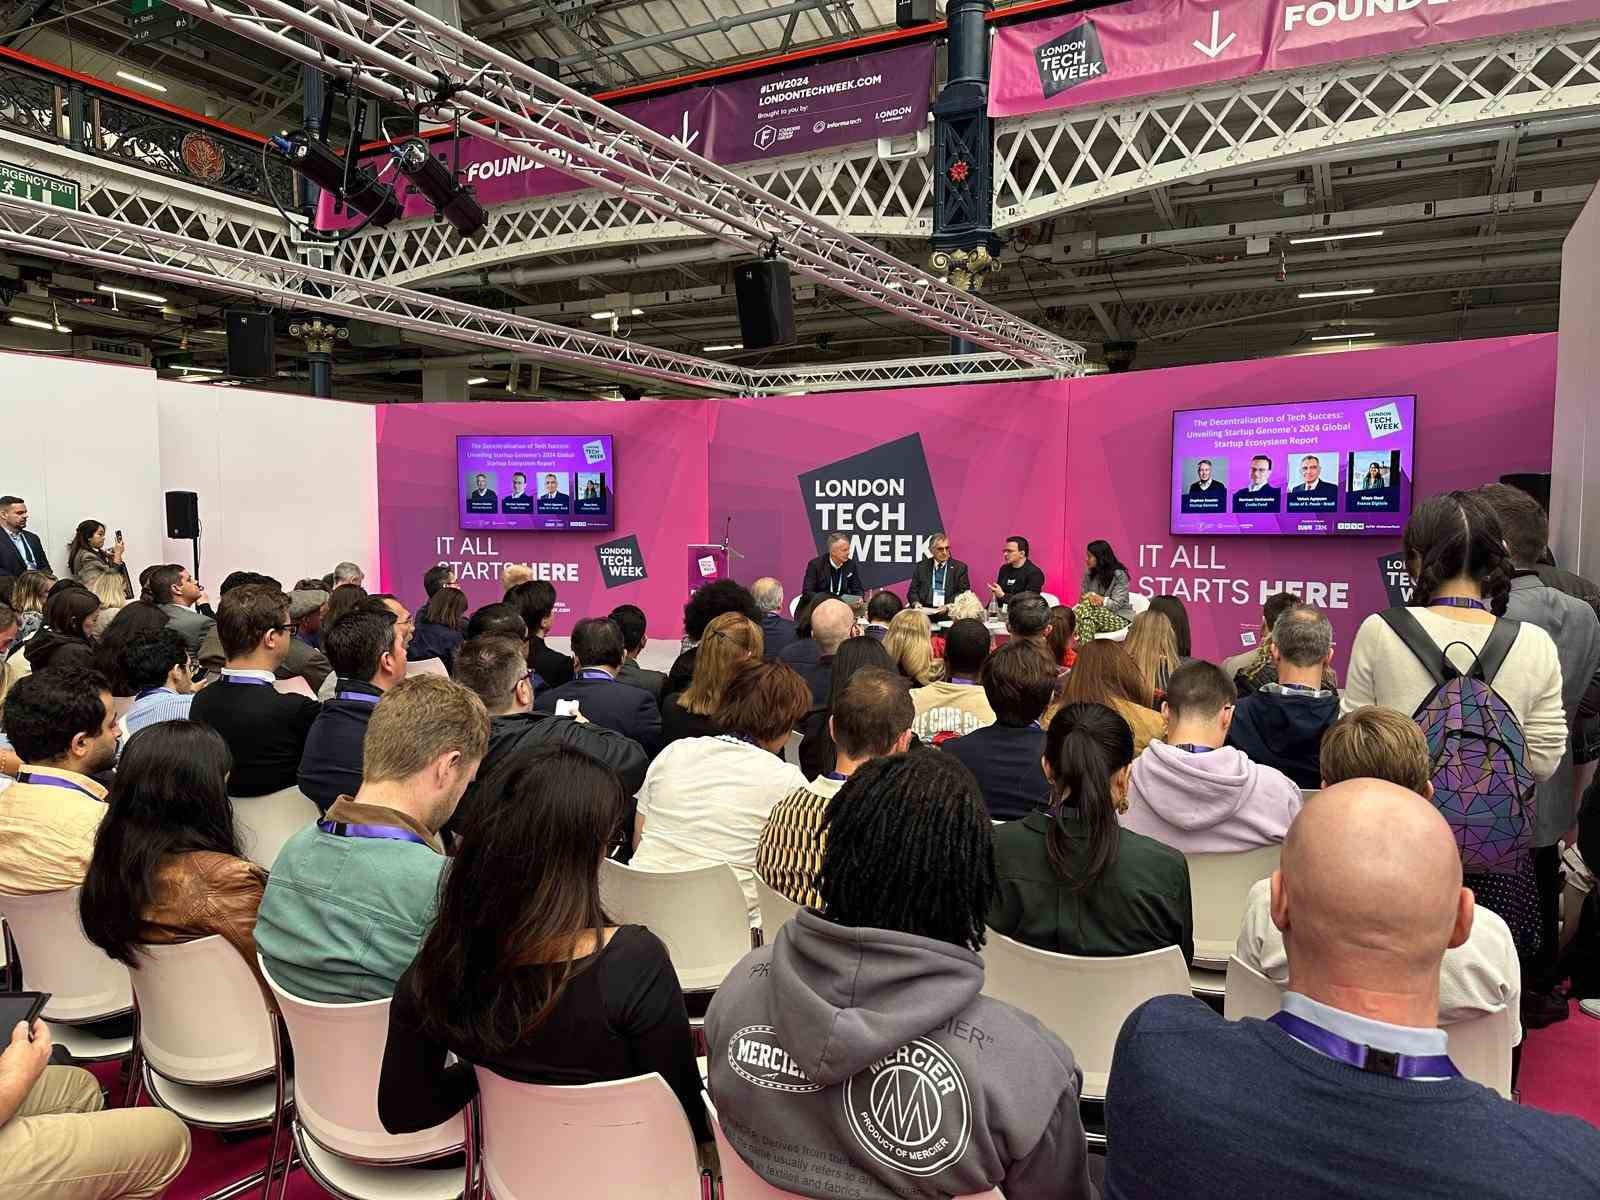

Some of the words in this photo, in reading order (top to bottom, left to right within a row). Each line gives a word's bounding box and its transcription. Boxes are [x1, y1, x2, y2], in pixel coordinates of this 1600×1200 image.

[1041, 40, 1086, 56] LONDON
[1041, 51, 1086, 71] TECH
[1052, 61, 1102, 81] WEEK
[759, 74, 882, 106] LONDONTECHWEEK.COM
[760, 77, 809, 95] #LTW2024
[875, 106, 912, 119] LONDON
[0, 167, 48, 187] RGENCY
[51, 182, 75, 195] EXIT
[1194, 419, 1208, 427] The
[1276, 414, 1285, 422] of
[1286, 413, 1306, 422] Tech
[1369, 416, 1392, 425] TECH
[1375, 422, 1400, 430] WEEK
[1186, 429, 1223, 439] Unveiling
[1224, 427, 1255, 438] Startup
[1299, 423, 1320, 433] 2024
[1322, 422, 1351, 432] Global
[1214, 440, 1244, 450] Startup
[1289, 436, 1319, 446] Report
[815, 478, 905, 497] LONDON
[815, 502, 905, 531] TECH
[436, 537, 454, 555] IT
[460, 537, 499, 555] ALL
[600, 548, 632, 556] LONDON
[600, 556, 632, 566] TECH
[1138, 544, 1163, 568] IT
[1170, 545, 1226, 569] ALL
[609, 566, 644, 577] WEEK
[1138, 576, 1250, 605] STARTS
[861, 1111, 895, 1152] PRODUCT
[896, 1147, 908, 1158] OF
[909, 1137, 950, 1160] MERCIER
